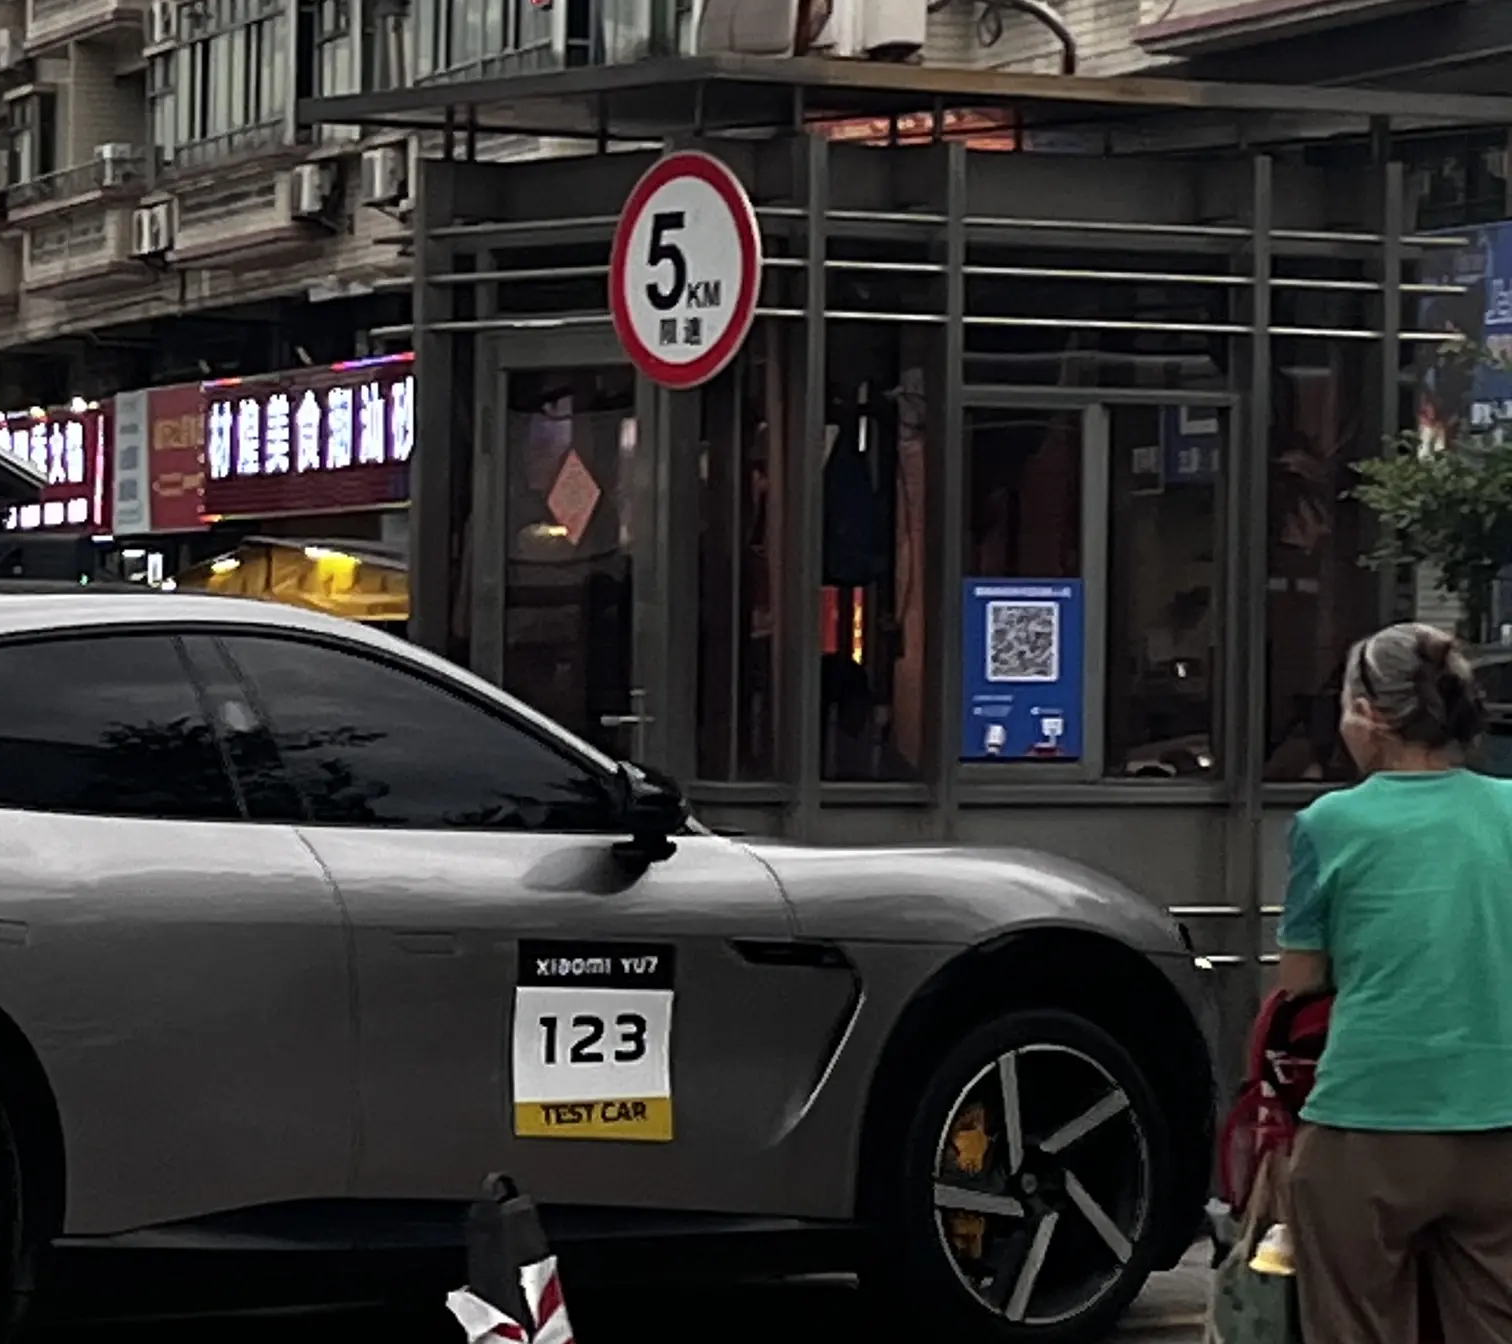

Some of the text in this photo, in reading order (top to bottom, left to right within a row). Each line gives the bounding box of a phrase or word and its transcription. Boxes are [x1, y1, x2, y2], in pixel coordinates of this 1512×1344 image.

[619, 955, 658, 974] YU7
[539, 1013, 648, 1065] 123
[540, 1101, 648, 1126] TEST CAR
